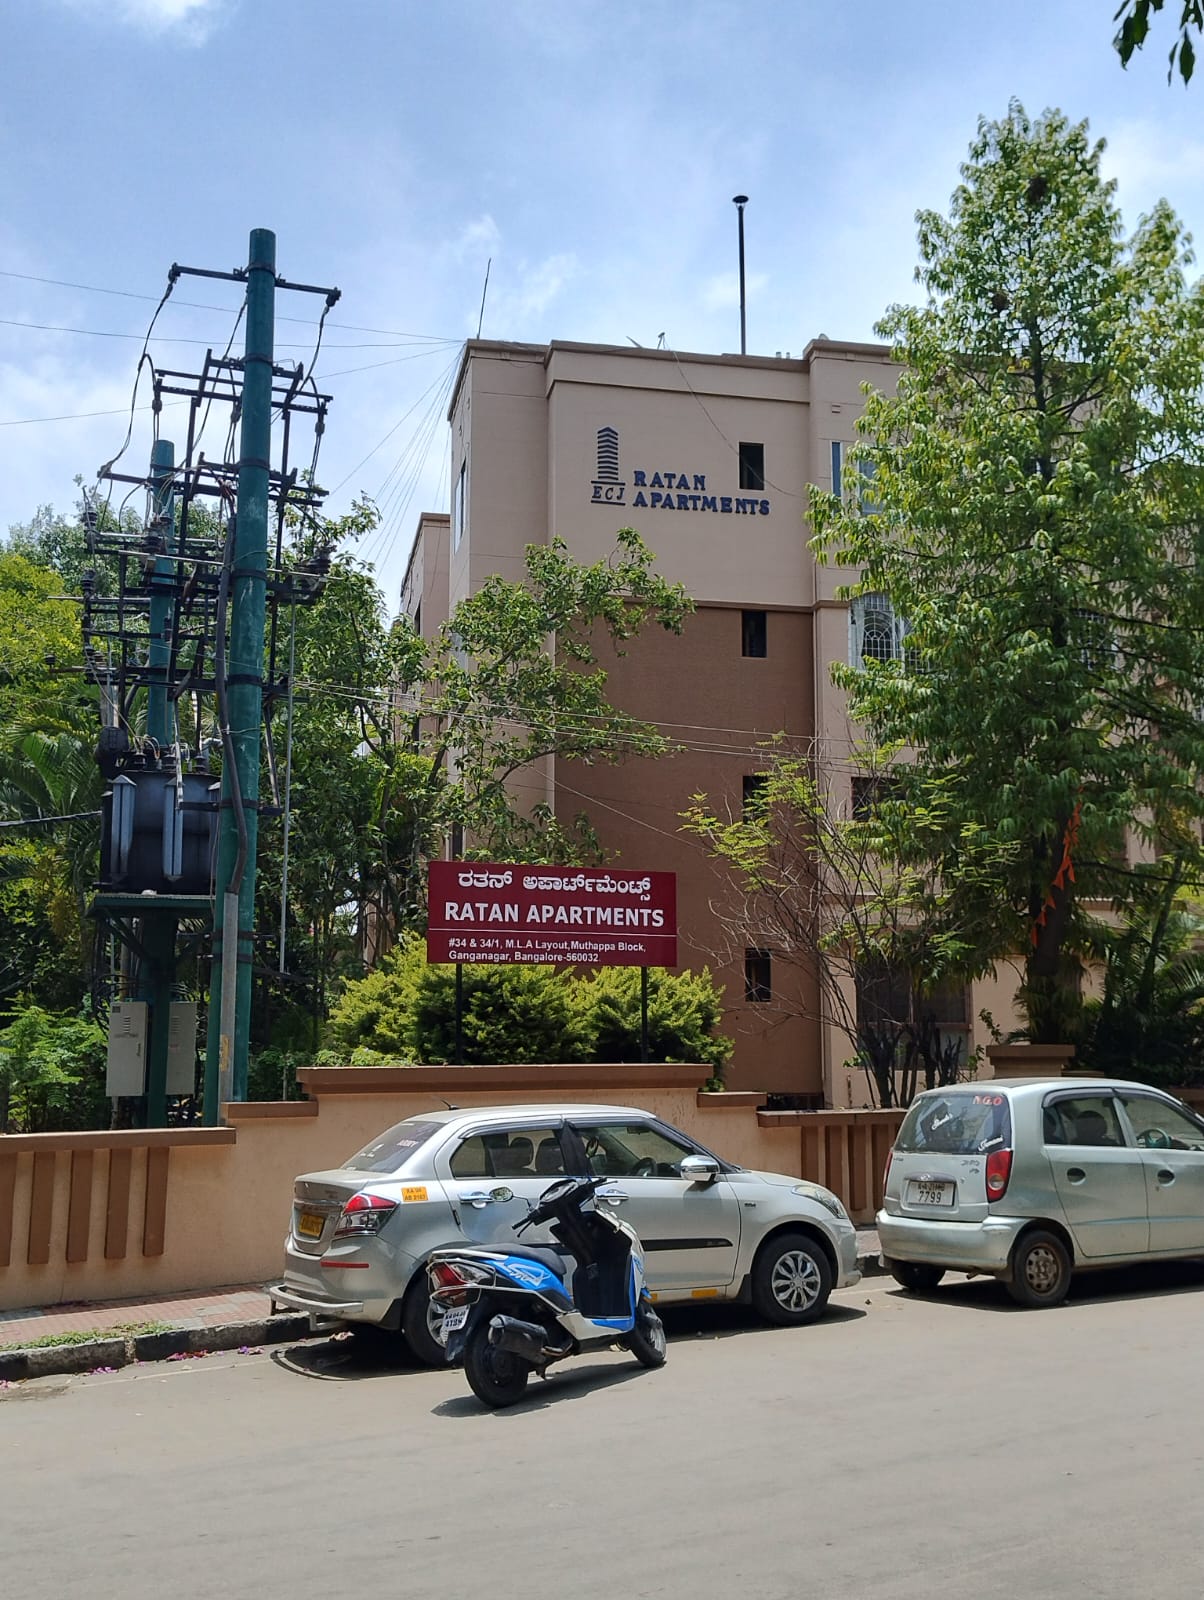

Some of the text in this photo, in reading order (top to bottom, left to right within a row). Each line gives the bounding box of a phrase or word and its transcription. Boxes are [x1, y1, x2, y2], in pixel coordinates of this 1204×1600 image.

[633, 470, 706, 491] RATAN
[592, 485, 625, 501] ECJ
[633, 491, 770, 516] APARTMENTS
[458, 869, 513, 889] ರತನ್
[445, 902, 664, 927] RATAN APARTMENTS
[448, 938, 467, 948] #34
[469, 939, 478, 948] &
[505, 939, 533, 949] M.L.A
[618, 942, 646, 953] Block,
[448, 950, 512, 963] Ganganagar,
[919, 1190, 942, 1204] 7799
